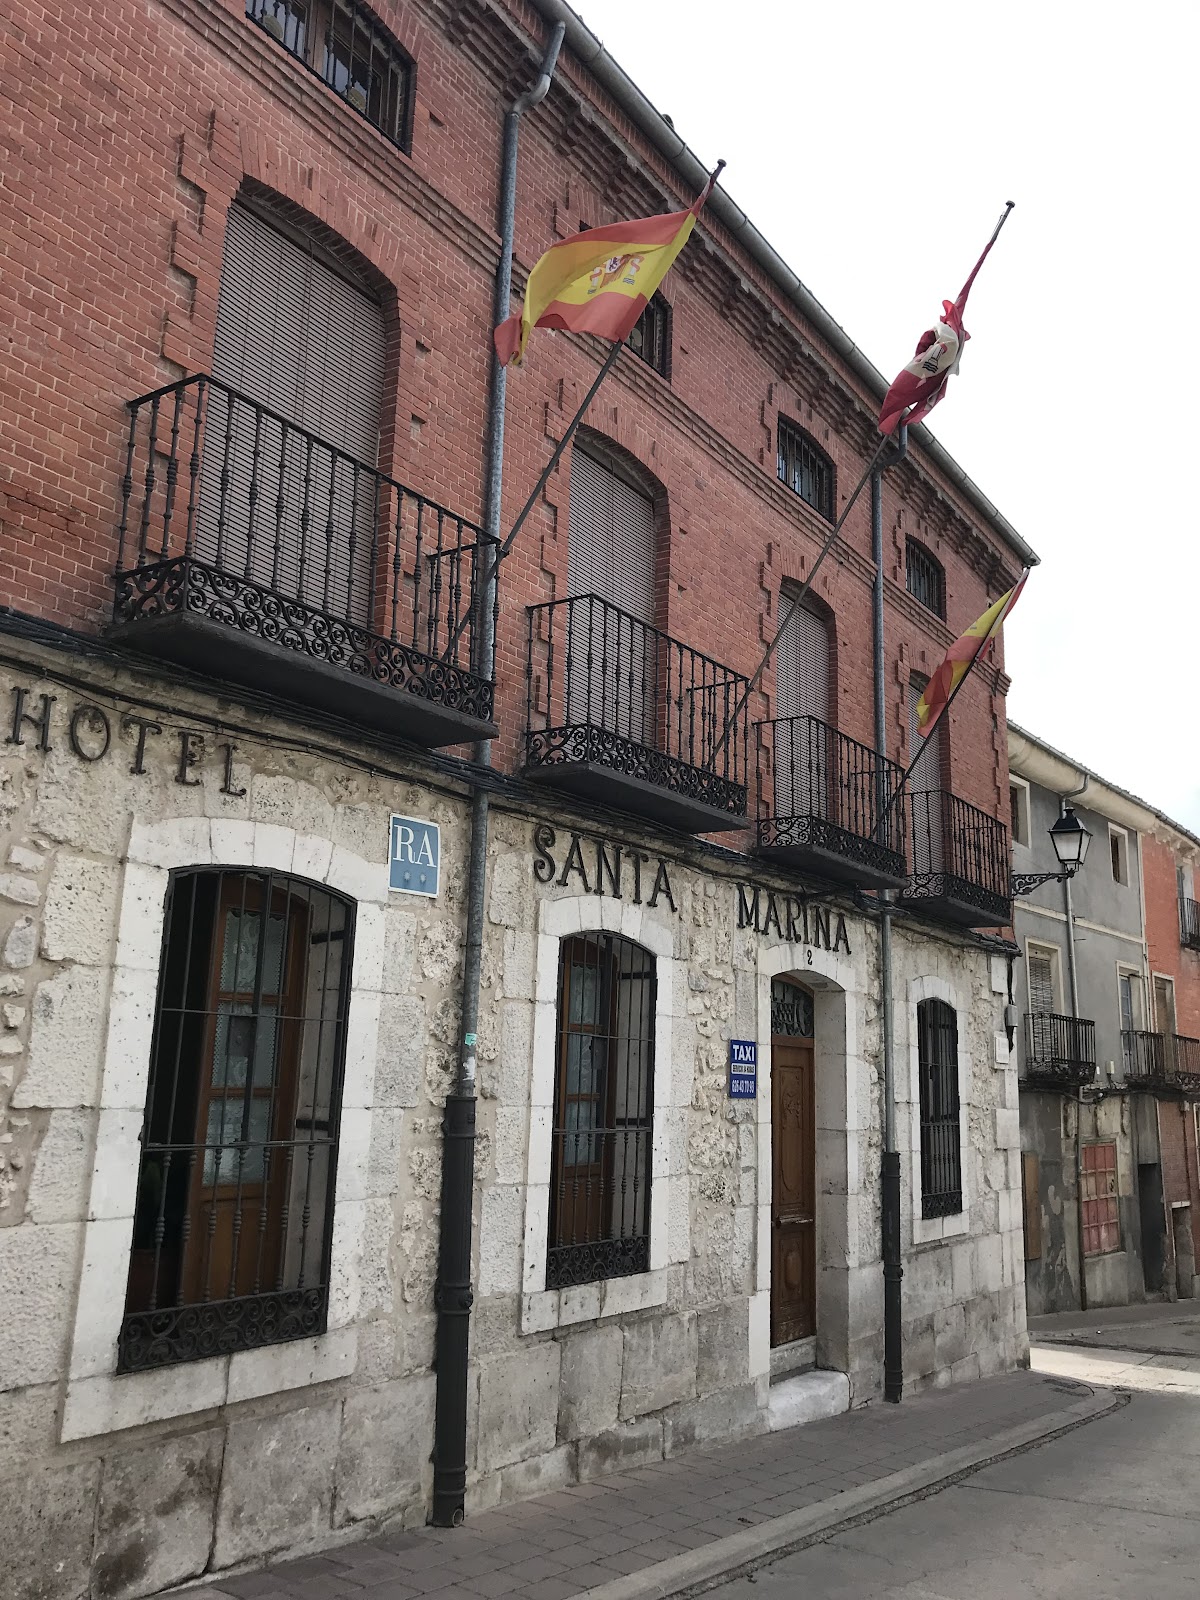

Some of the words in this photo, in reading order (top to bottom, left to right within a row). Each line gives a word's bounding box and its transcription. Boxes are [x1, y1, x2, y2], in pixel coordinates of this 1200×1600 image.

[5, 686, 247, 796] HOTEL
[533, 825, 677, 912] SANTA
[736, 883, 852, 955] MARINA
[393, 825, 437, 868] RA
[807, 950, 812, 965] 2
[733, 1045, 755, 1061] TAXI
